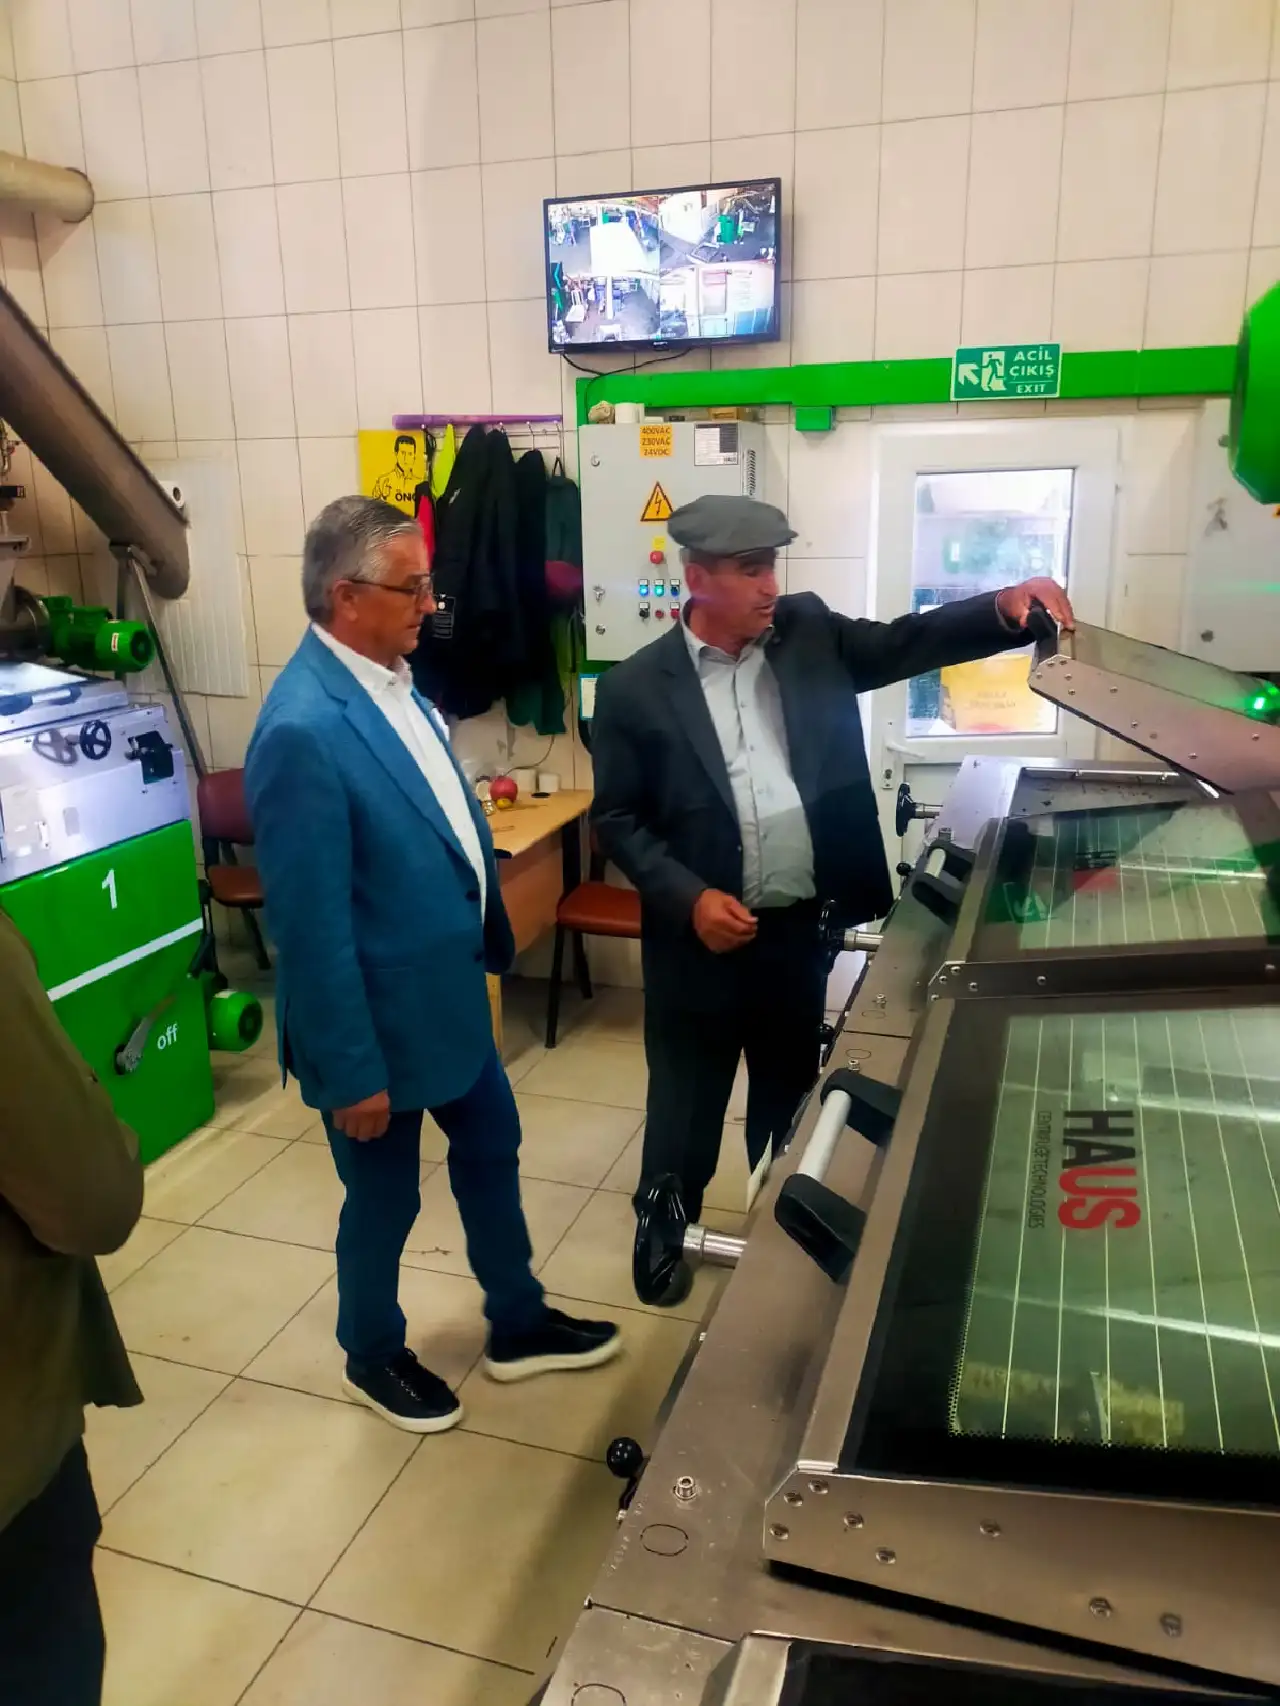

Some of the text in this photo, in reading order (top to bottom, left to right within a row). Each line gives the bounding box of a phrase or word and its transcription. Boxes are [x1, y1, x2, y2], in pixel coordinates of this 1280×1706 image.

[1009, 364, 1055, 380] ÇIKIŞ
[1016, 383, 1046, 394] EXIT
[101, 868, 118, 909] 1
[157, 1023, 178, 1050] off
[1058, 1110, 1141, 1229] HAUS
